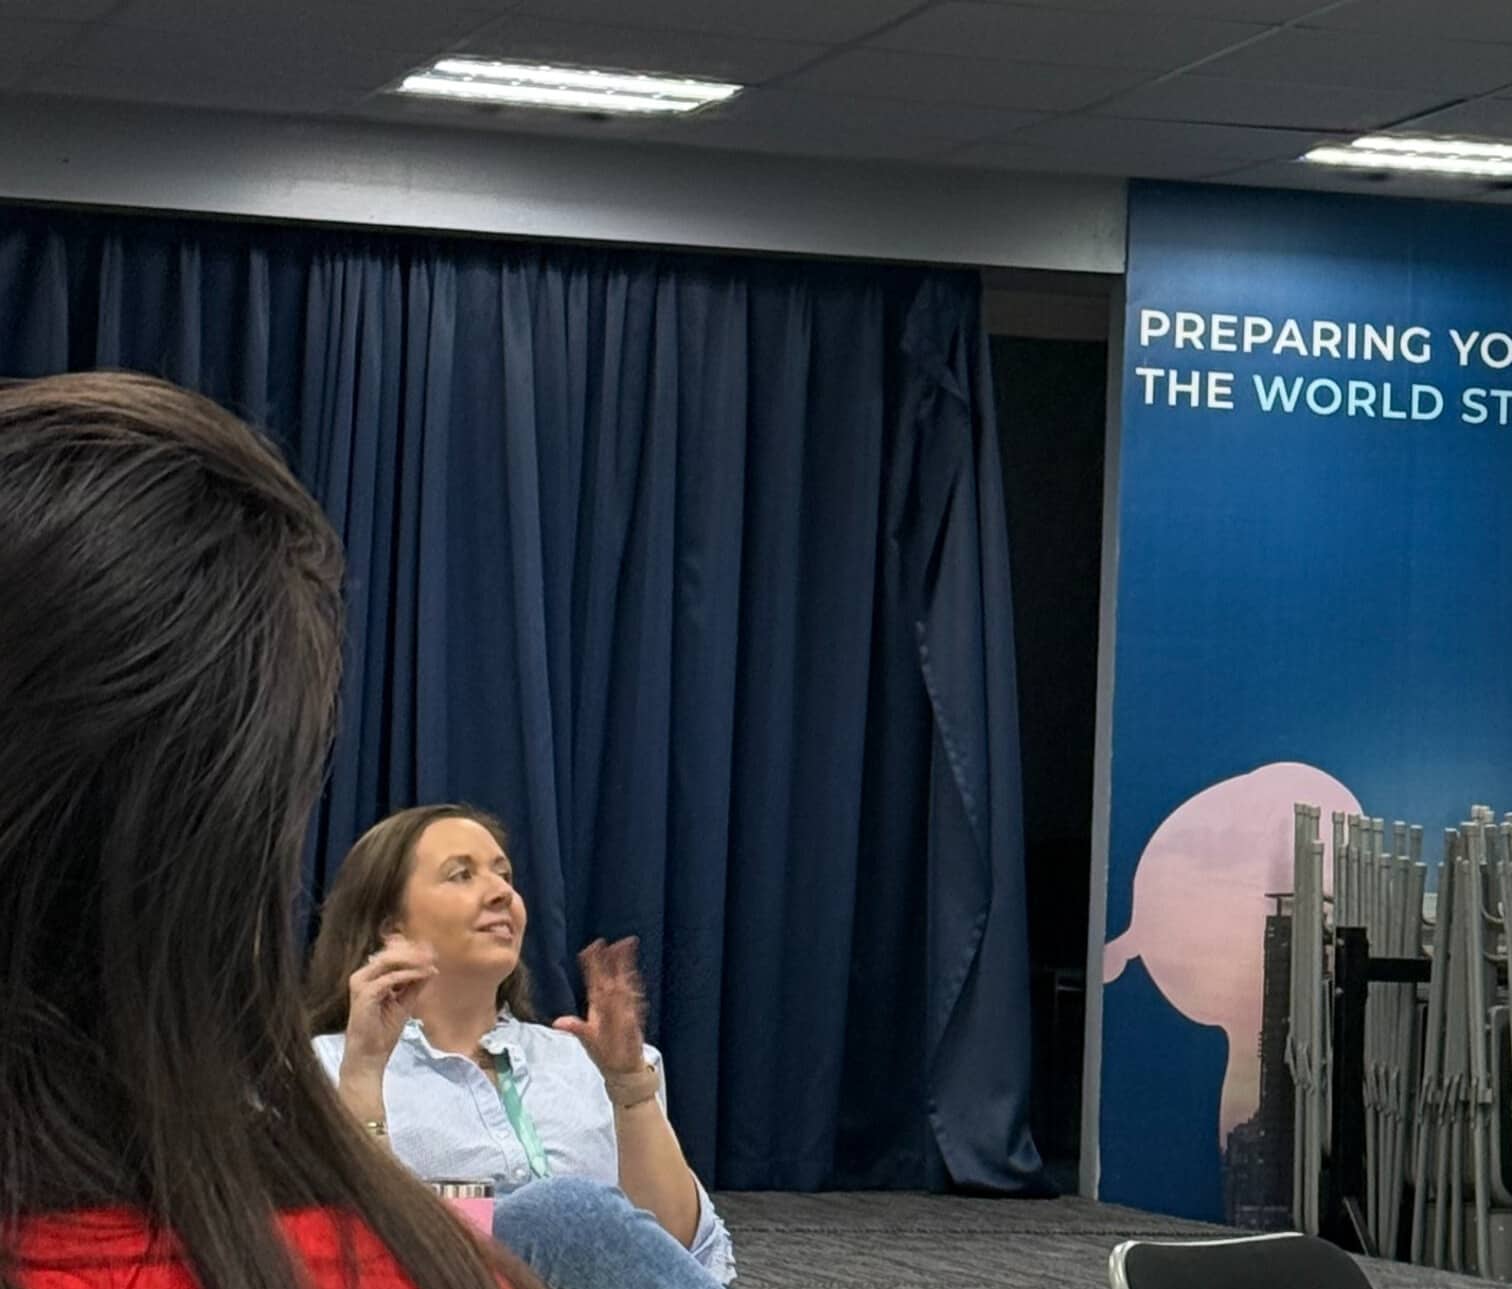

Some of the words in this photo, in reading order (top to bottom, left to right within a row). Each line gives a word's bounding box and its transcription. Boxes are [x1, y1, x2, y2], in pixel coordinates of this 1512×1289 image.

[1139, 307, 1432, 364] PREPARING
[1135, 366, 1236, 409] THE
[1251, 374, 1445, 421] WORLD
